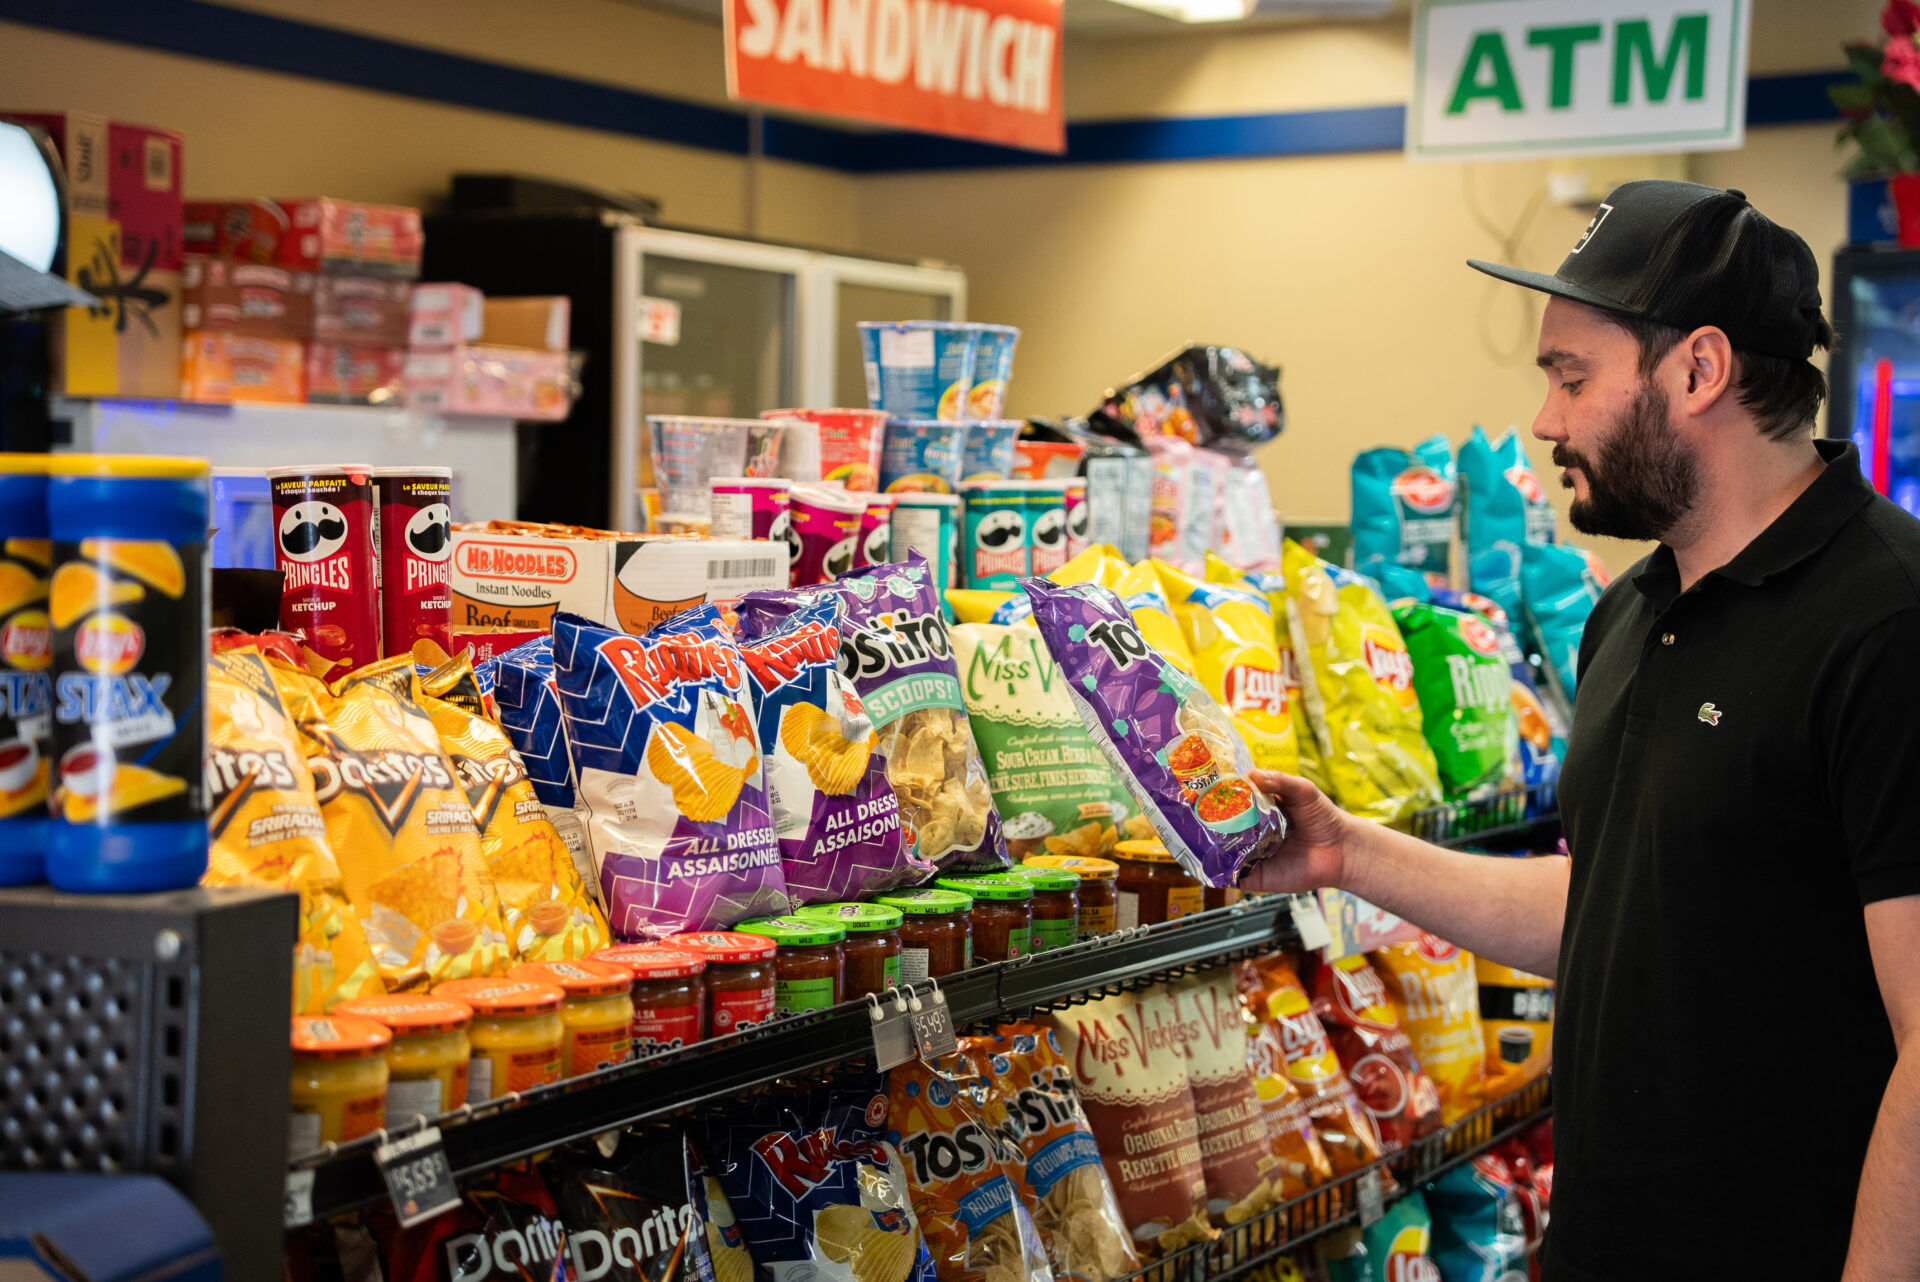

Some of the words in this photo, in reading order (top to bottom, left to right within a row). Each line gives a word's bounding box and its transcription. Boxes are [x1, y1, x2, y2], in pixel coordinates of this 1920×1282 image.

[739, 0, 1056, 114] SANDWICH
[1445, 12, 1710, 116] ATM
[281, 481, 307, 490] SAVEUR
[308, 479, 347, 488] PARFAITE
[411, 483, 438, 491] SAVEUR
[282, 556, 350, 593] PRINGLES
[475, 582, 509, 597] Instant
[511, 584, 553, 599] Noodles
[291, 602, 337, 612] KETCHUP
[466, 604, 511, 627] Beef
[967, 634, 1031, 701] Miss
[55, 671, 172, 725] STAX
[867, 679, 953, 719] SCOOPS!
[306, 751, 452, 803] Doritos
[825, 808, 857, 833] ALL
[682, 836, 721, 857] ALL
[852, 921, 871, 929] DOUCE
[1075, 1018, 1129, 1086] Miss
[1123, 1123, 1174, 1156] ORIGINAL
[1201, 1129, 1243, 1157] ECETTE
[1117, 1149, 1179, 1183] RECETTE
